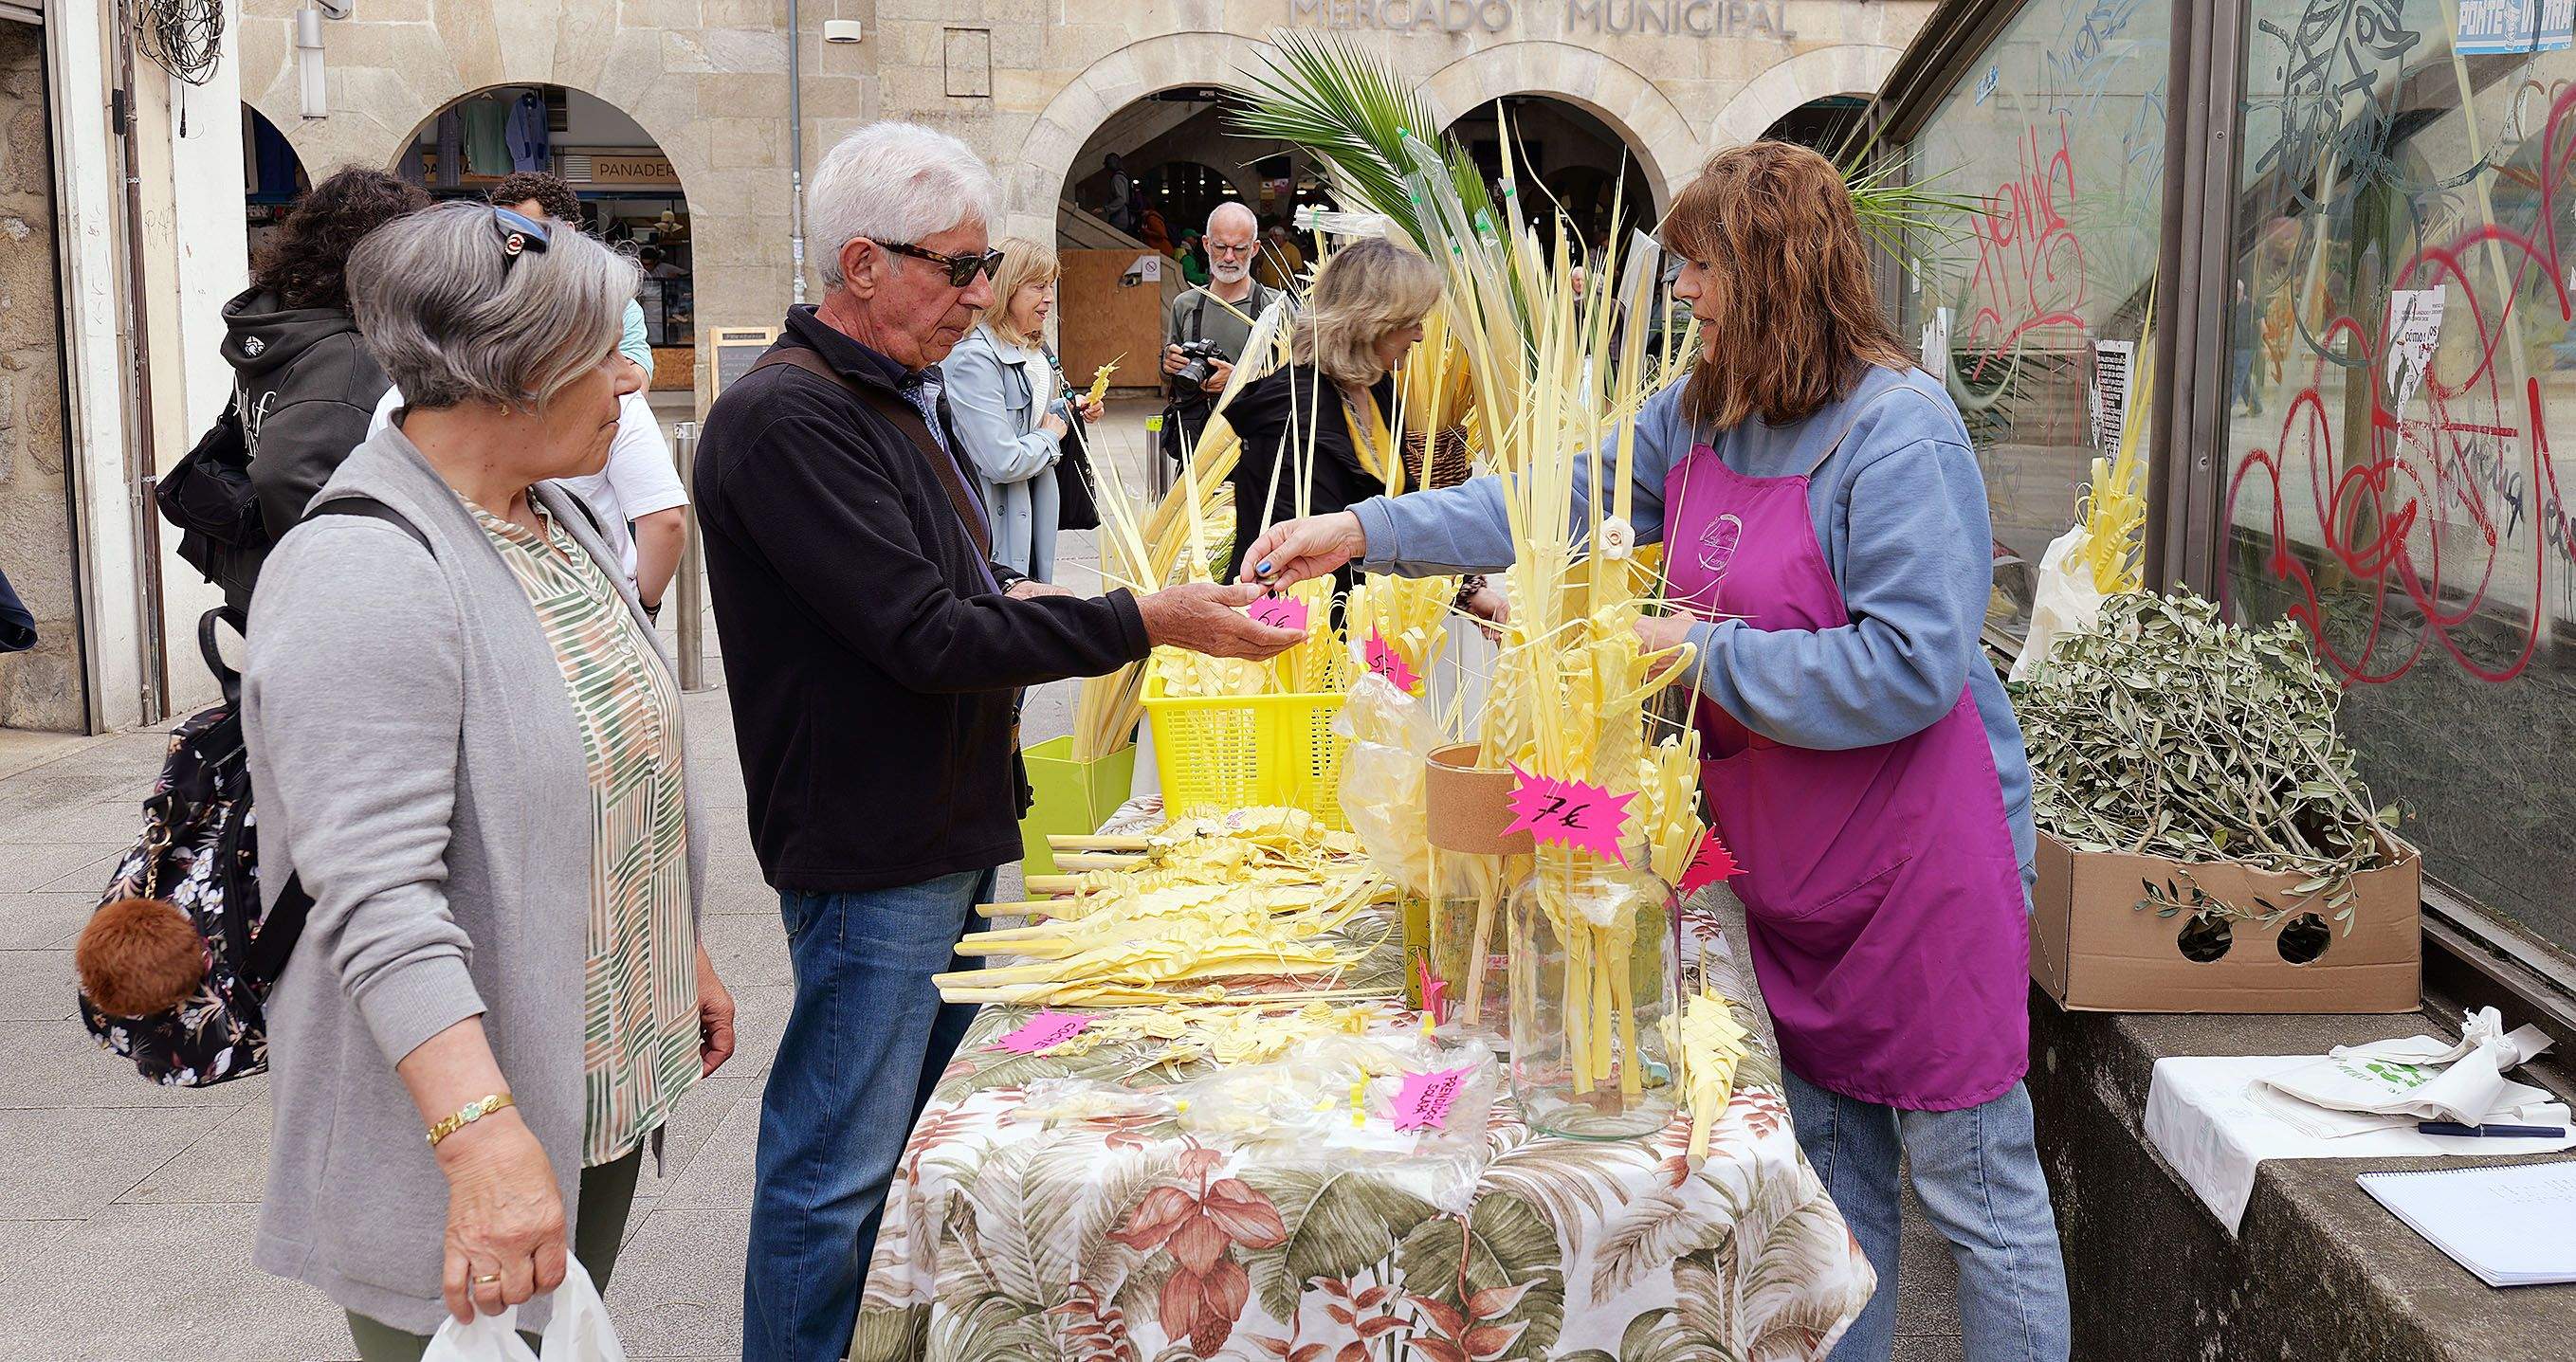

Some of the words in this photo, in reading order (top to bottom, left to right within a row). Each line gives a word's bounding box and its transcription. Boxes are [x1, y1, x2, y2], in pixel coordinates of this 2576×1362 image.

[1289, 0, 1512, 32] MERCADO
[1568, 0, 1798, 38] MUNICIPAL
[1531, 794, 1591, 830] 7€
